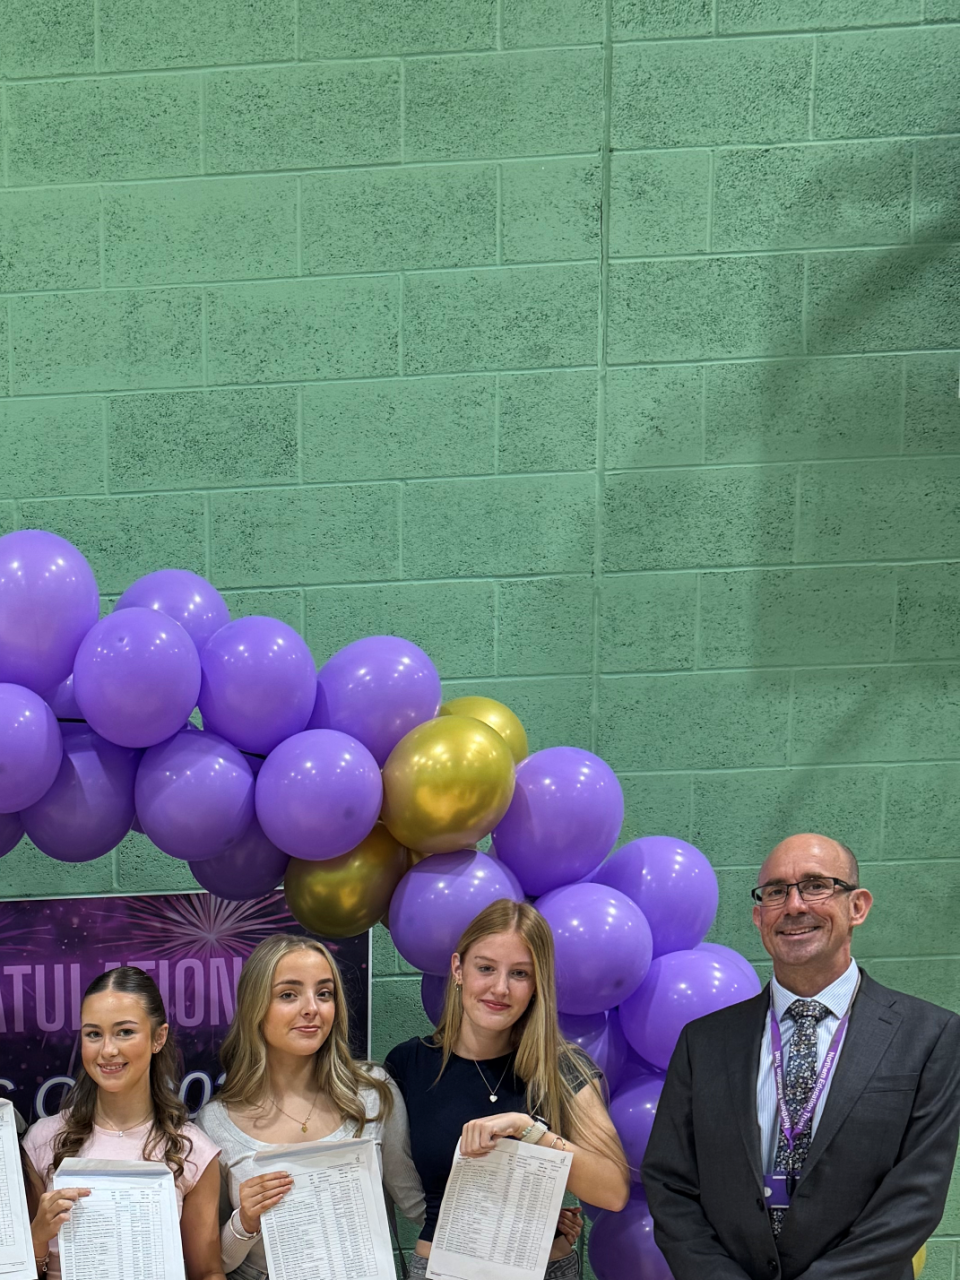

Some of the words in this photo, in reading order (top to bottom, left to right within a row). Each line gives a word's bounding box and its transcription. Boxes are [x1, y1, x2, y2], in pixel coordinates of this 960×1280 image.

[820, 1051, 836, 1079] Northern
[776, 1067, 784, 1099] Education
[805, 1078, 826, 1111] Education
[780, 1098, 791, 1129] Northern
[797, 1112, 811, 1129] Trust
